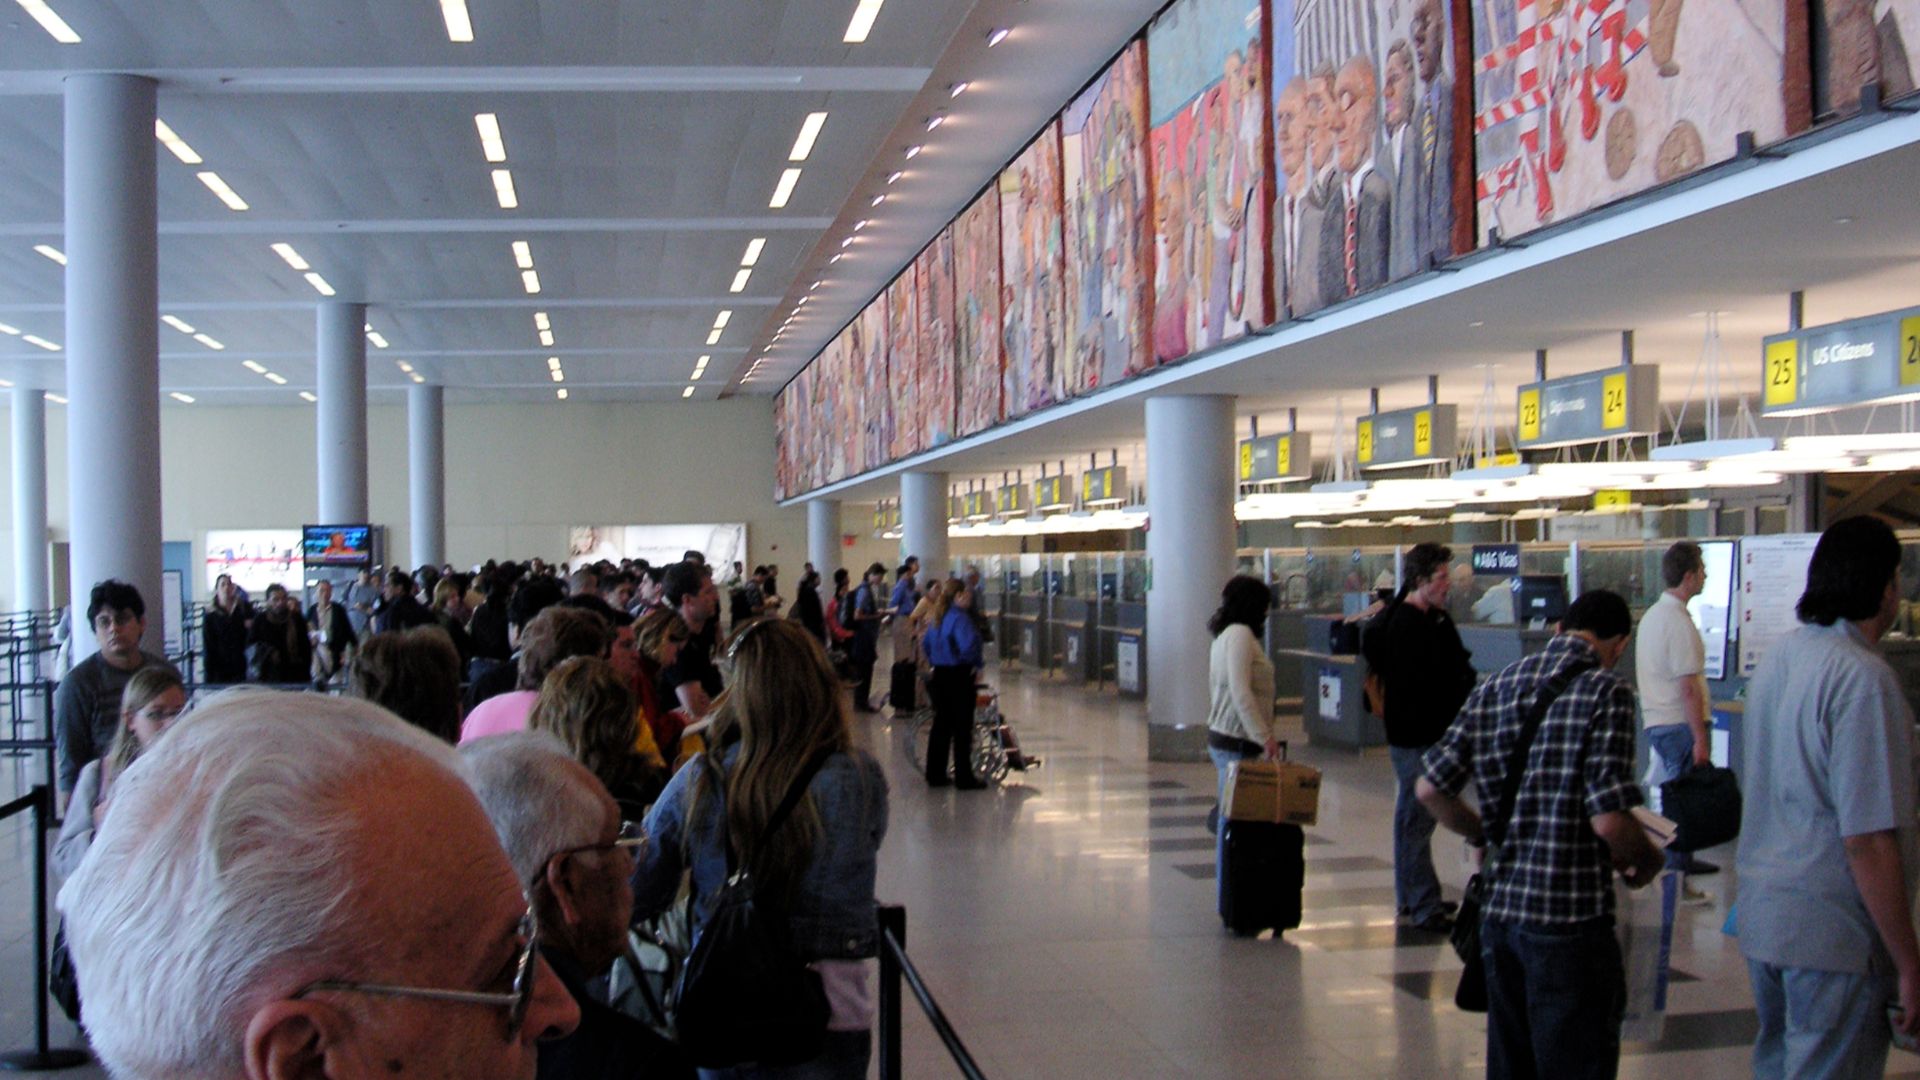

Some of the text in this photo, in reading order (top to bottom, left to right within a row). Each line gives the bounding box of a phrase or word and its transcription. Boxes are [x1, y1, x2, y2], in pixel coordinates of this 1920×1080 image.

[1812, 341, 1875, 366] US Citizens
[1772, 358, 1792, 386] 25
[1606, 388, 1622, 413] 24
[1524, 402, 1536, 426] 23
[1418, 422, 1429, 443] 22
[1498, 550, 1519, 568] Visas
